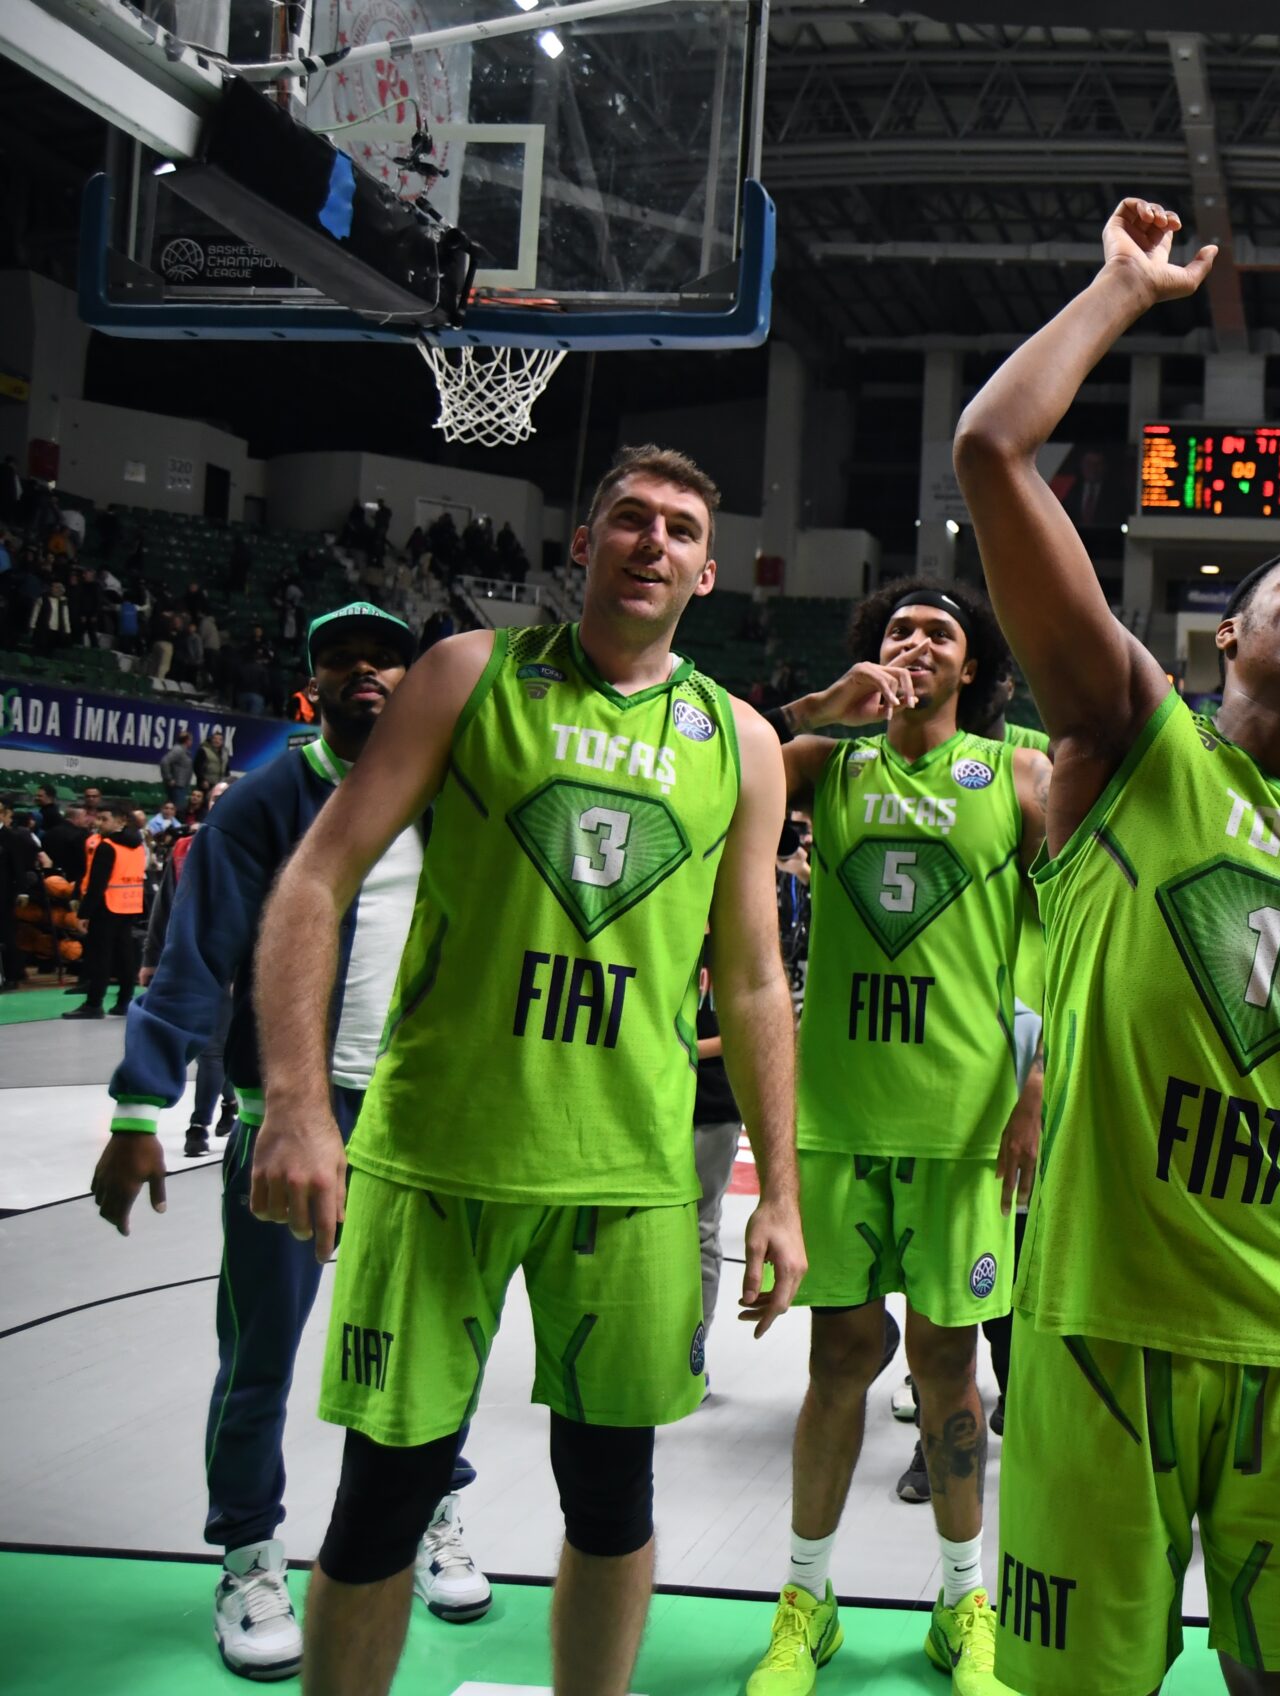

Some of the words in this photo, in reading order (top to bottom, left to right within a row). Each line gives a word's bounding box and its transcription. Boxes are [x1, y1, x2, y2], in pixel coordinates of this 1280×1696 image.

[206, 268, 252, 279] LEAGUE
[207, 244, 262, 256] BASKETB
[552, 723, 676, 794] TOFAŞ
[570, 806, 631, 888] 3
[863, 793, 957, 834] TOFAŞ
[879, 850, 917, 913] 5
[512, 950, 637, 1049] FIAT
[848, 971, 935, 1045] FIAT
[341, 1322, 394, 1392] FIAT
[1000, 1551, 1077, 1650] FIAT
